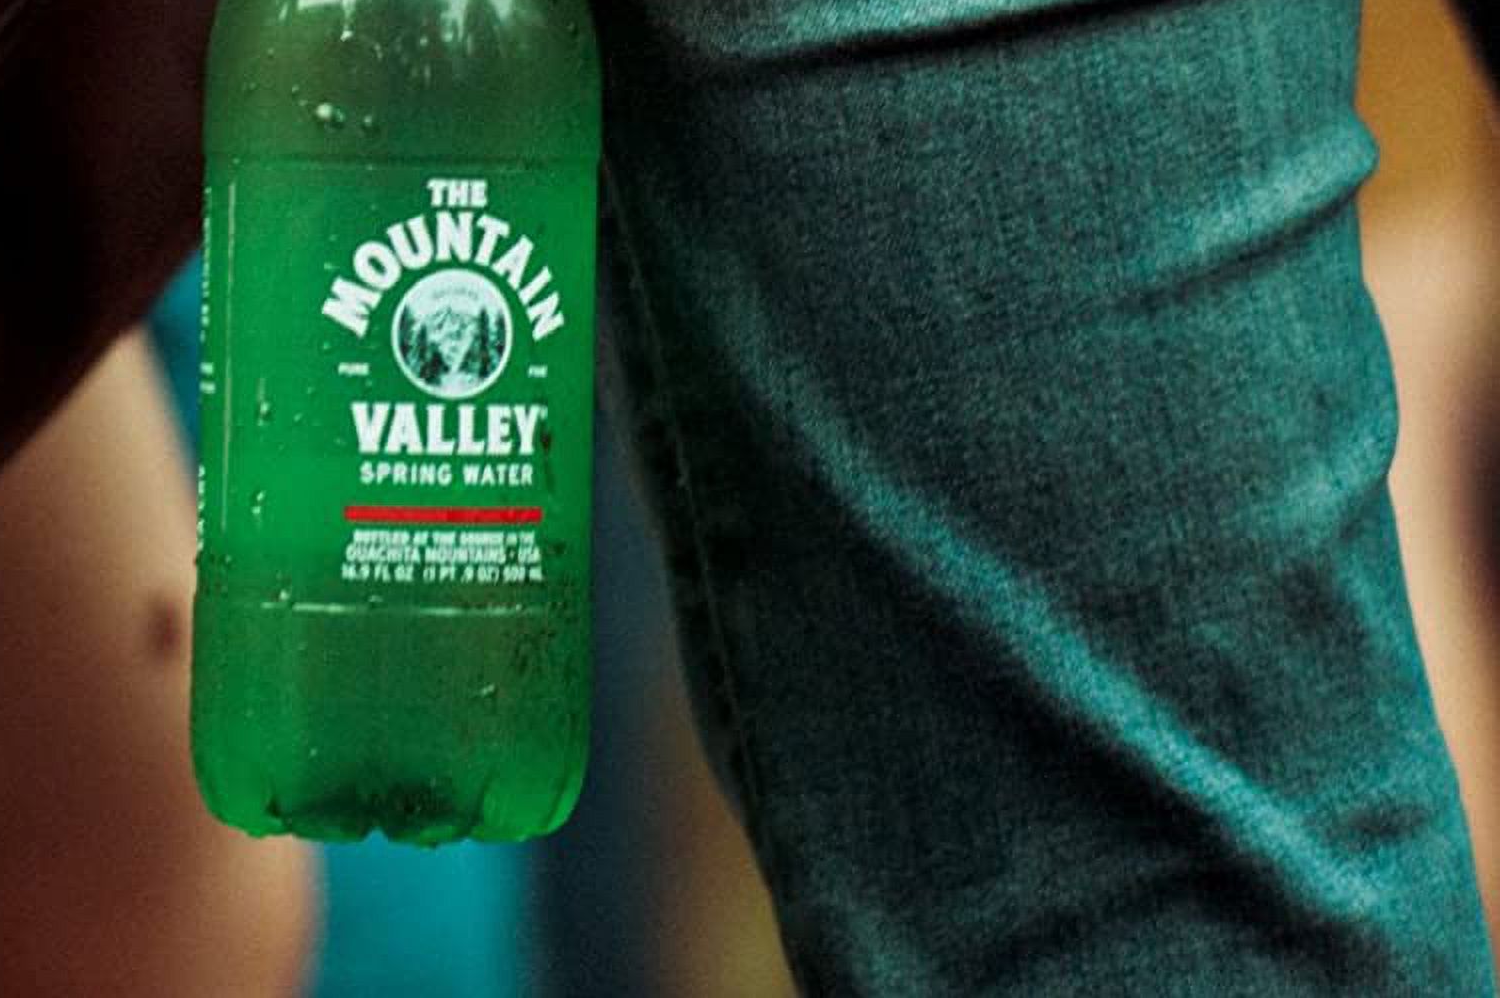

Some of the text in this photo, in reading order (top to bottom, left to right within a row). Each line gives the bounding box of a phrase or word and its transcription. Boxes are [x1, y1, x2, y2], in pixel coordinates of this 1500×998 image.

[428, 178, 488, 208] THE
[322, 211, 564, 341] MOUNTAIN
[360, 463, 534, 486] SPRING WATER
[424, 545, 507, 564] MOUNTAINS
[518, 546, 542, 564] USA
